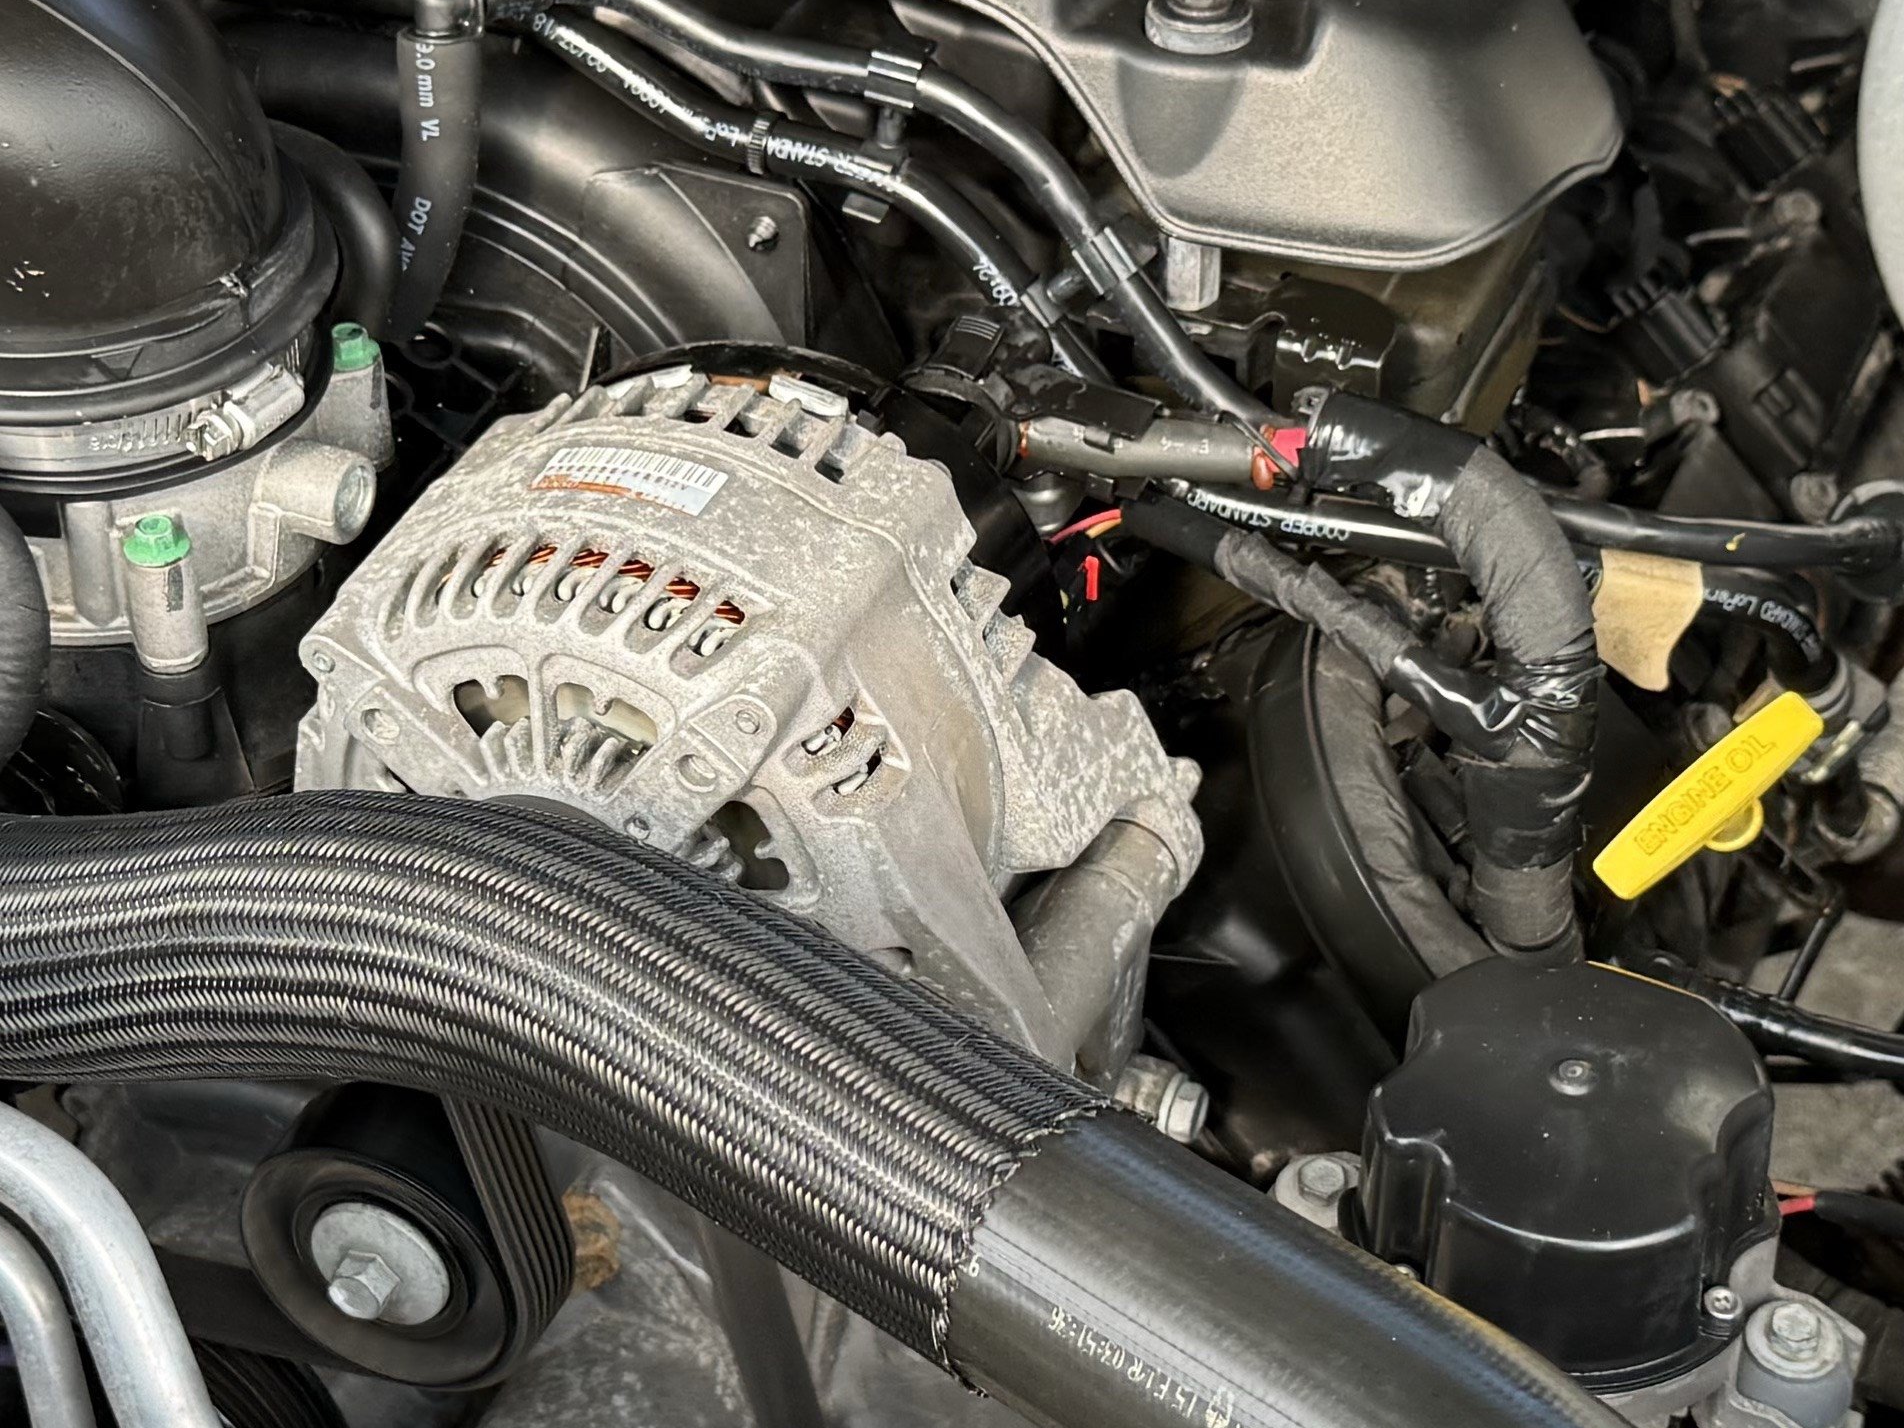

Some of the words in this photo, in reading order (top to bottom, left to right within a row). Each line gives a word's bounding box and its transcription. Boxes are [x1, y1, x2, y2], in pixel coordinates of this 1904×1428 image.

[418, 74, 436, 109] mm
[411, 195, 432, 236] DOT
[1187, 491, 1273, 528] STANDARD
[1280, 515, 1351, 542] COOPER
[1636, 775, 1728, 856] ENGINE
[1729, 734, 1777, 777] OIL
